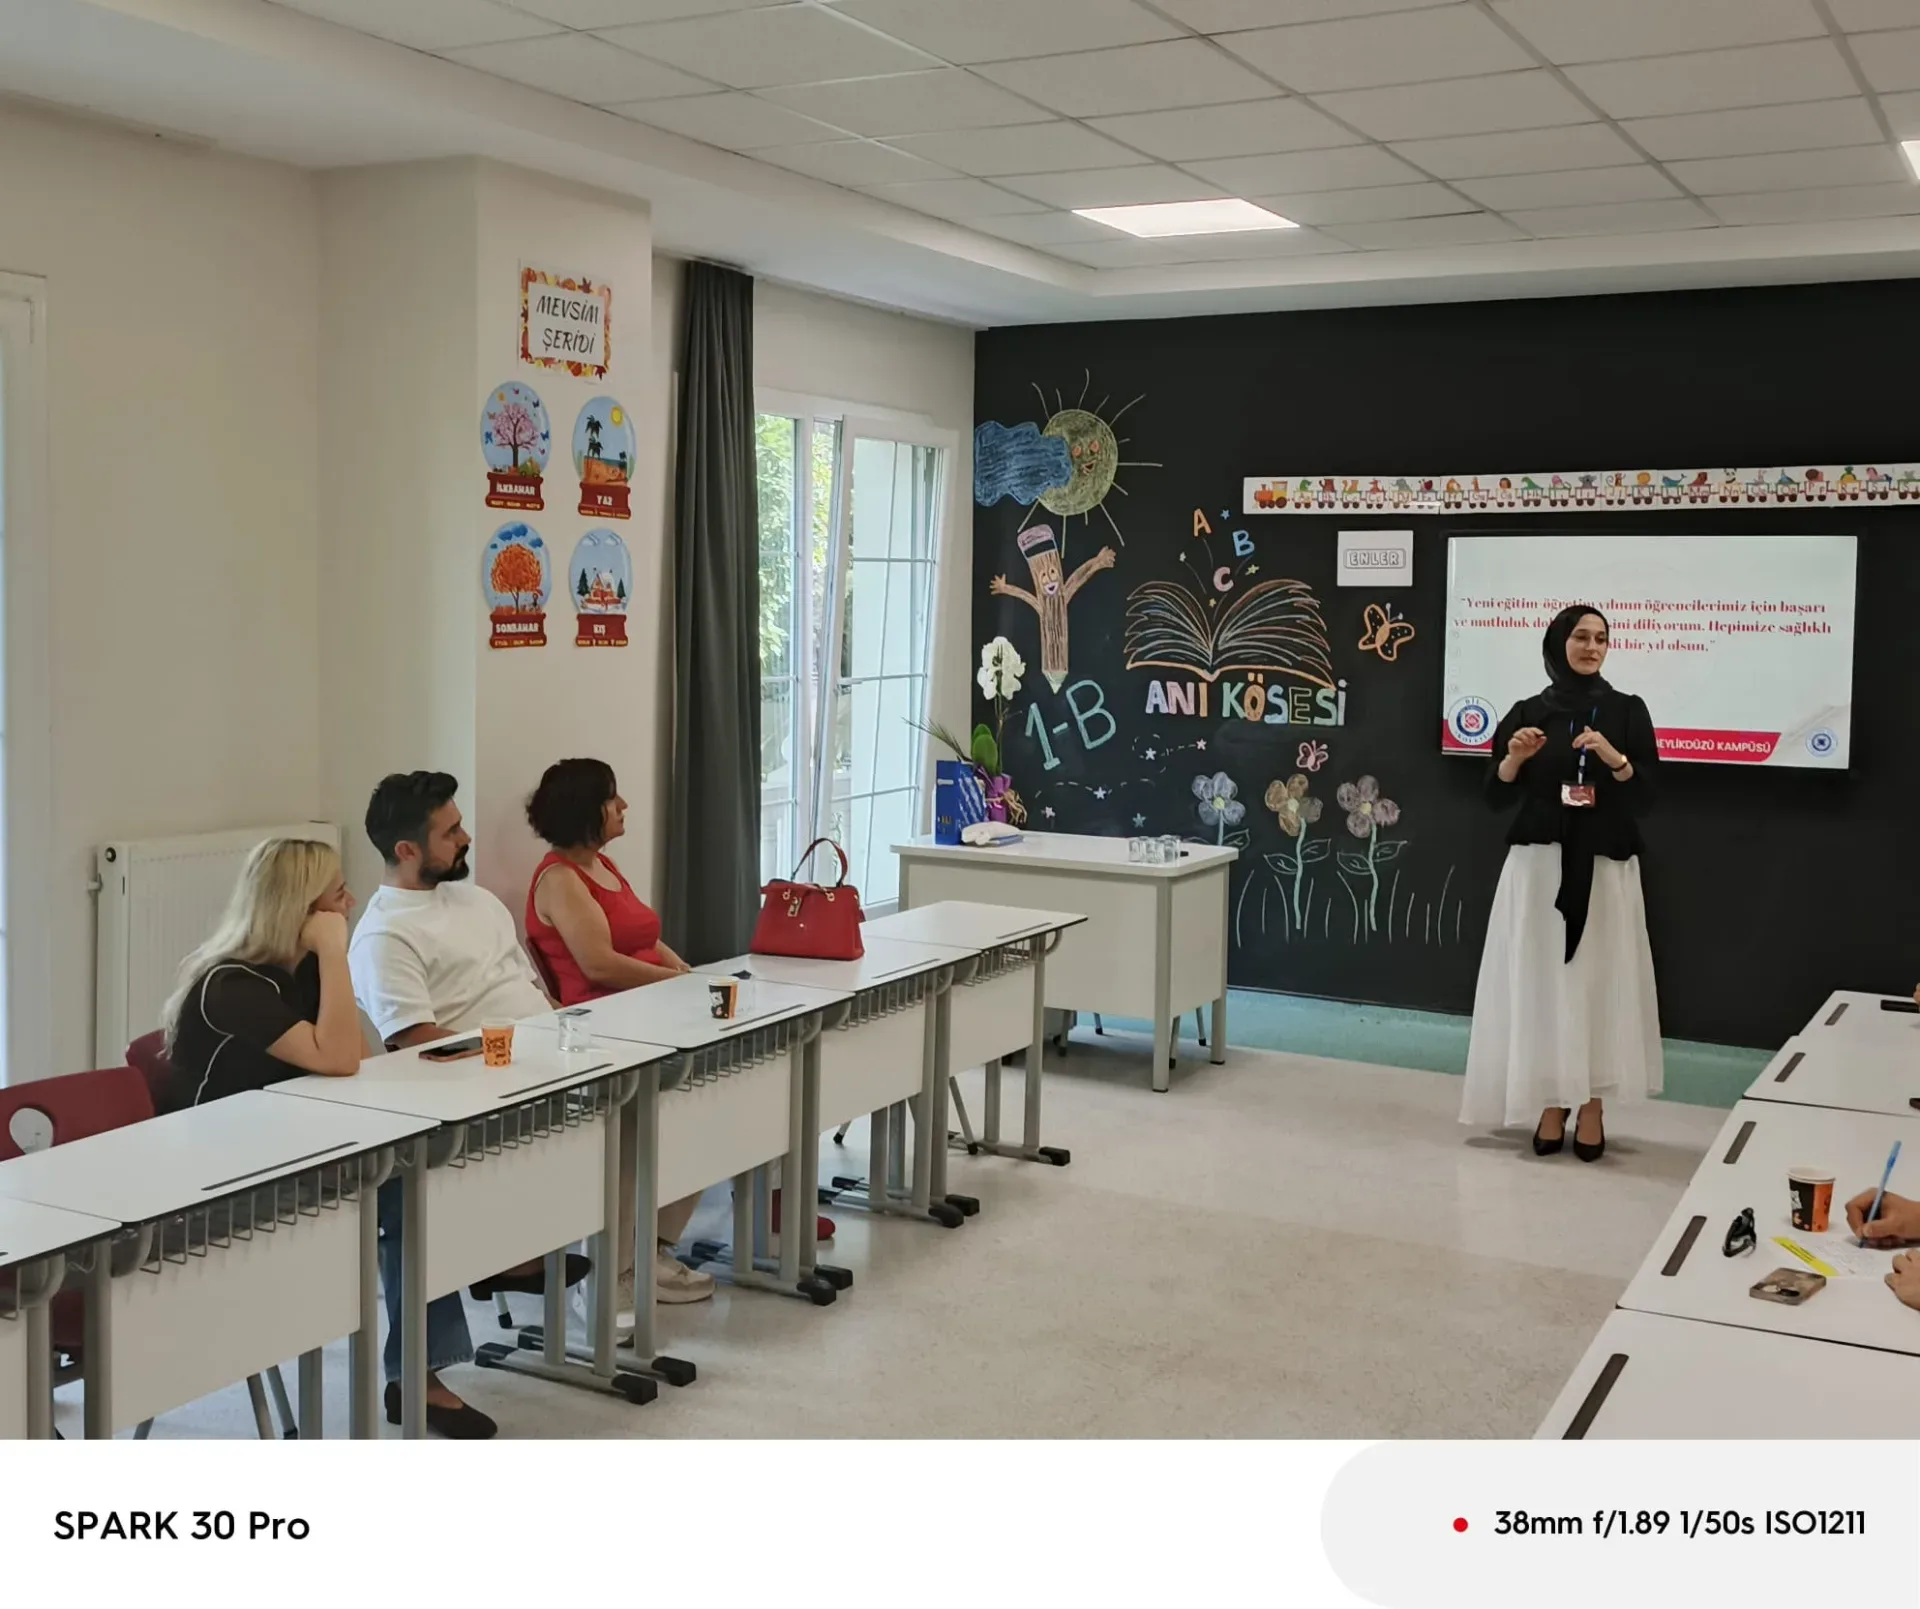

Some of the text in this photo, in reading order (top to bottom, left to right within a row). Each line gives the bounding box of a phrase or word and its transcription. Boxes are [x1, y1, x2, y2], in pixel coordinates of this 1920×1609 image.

[536, 295, 599, 324] MEVSİM
[542, 328, 596, 354] ŞERİDİ
[1193, 509, 1212, 537] A
[1232, 530, 1255, 557] B
[1349, 551, 1400, 566] ENLER
[1213, 567, 1234, 592] C
[1497, 597, 1538, 612] eğitim
[1750, 600, 1777, 614] için
[1780, 601, 1826, 616] başarı
[1633, 618, 1705, 634] diliyorum.
[1708, 620, 1775, 635] Hepimize
[1779, 621, 1832, 637] sağlıklı
[1625, 638, 1642, 650] bir
[1145, 680, 1208, 718] ANI
[1024, 680, 1117, 771] 1-B
[1717, 741, 1772, 754] KAMPÜSÜ
